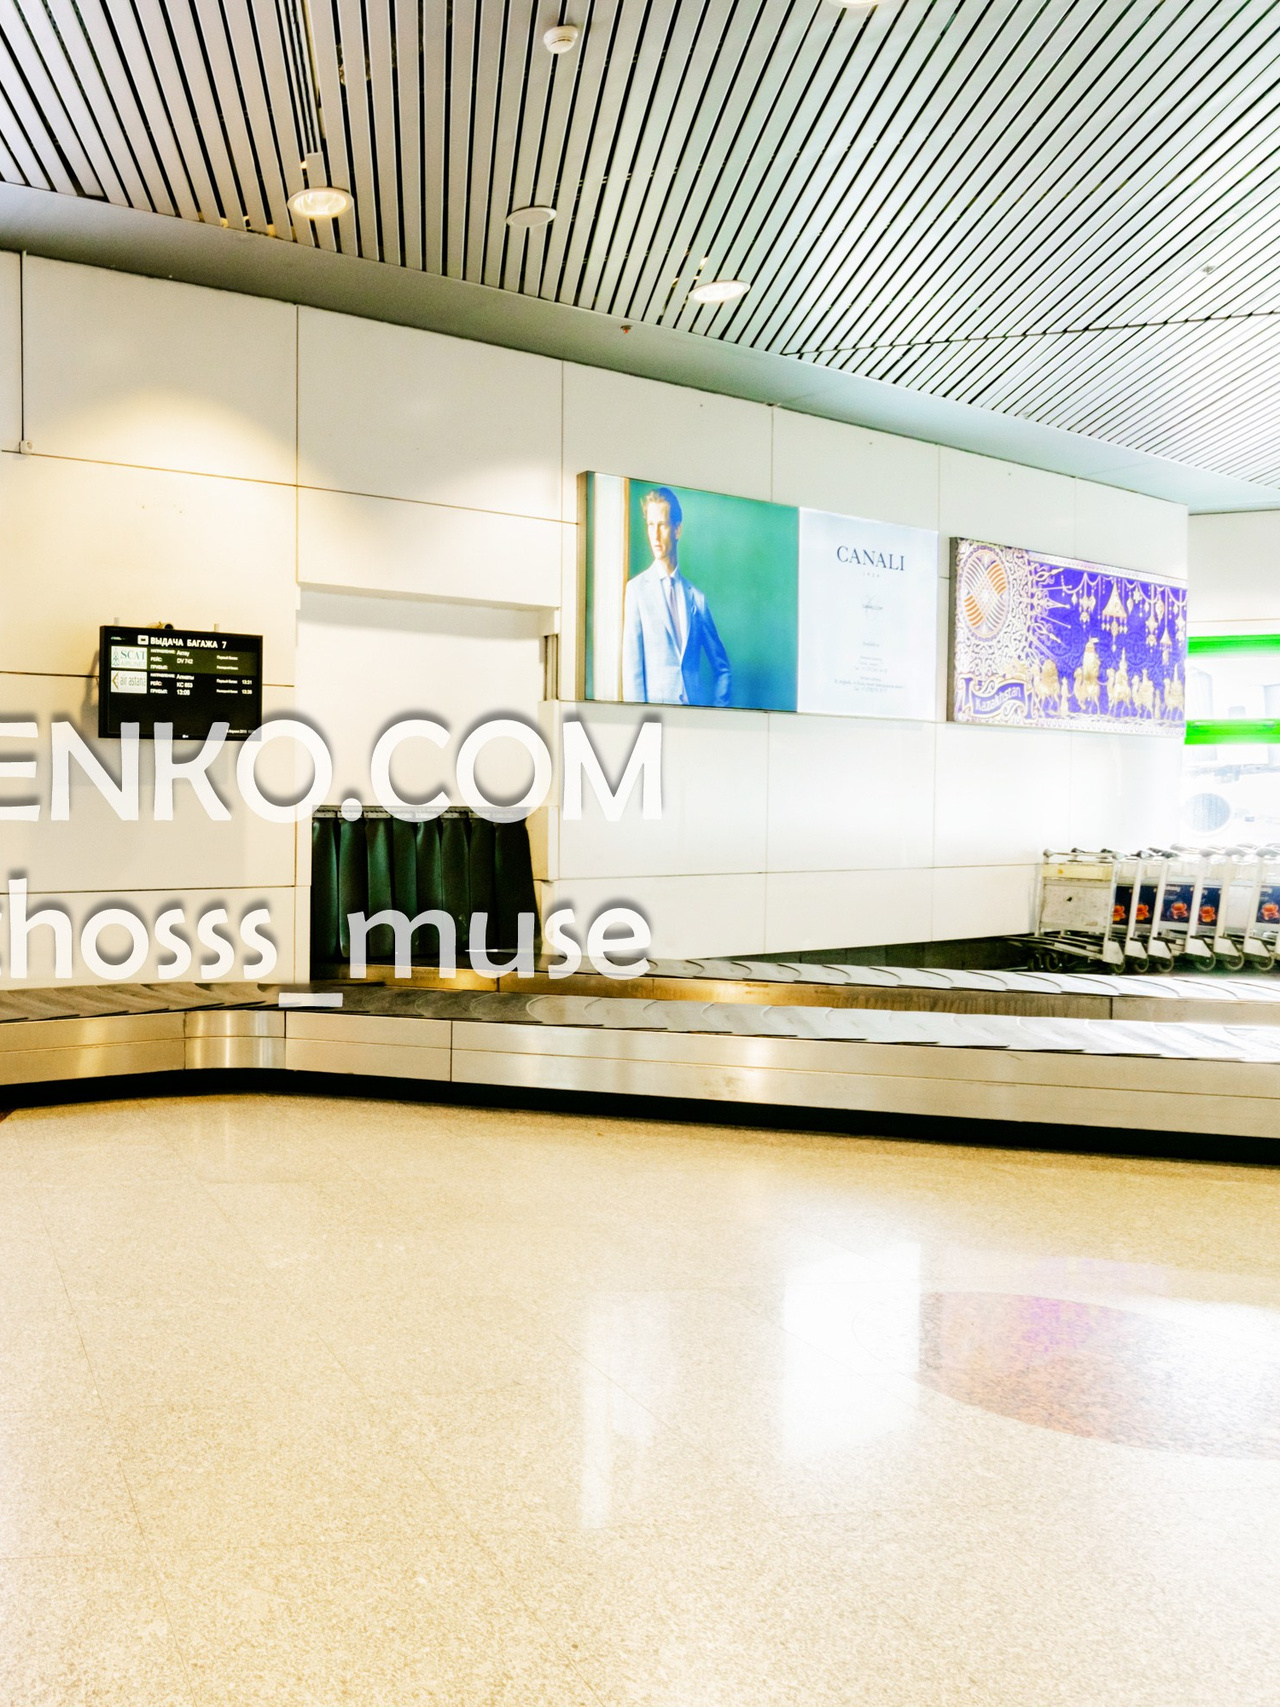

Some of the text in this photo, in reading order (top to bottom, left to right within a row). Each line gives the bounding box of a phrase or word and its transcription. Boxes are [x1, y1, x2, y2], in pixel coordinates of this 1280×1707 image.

[836, 545, 905, 571] CANALI
[150, 637, 227, 649] ВЫДАЧА БАГАЖА 7
[120, 650, 146, 660] SCAT
[975, 686, 1022, 711] Kazakhstan
